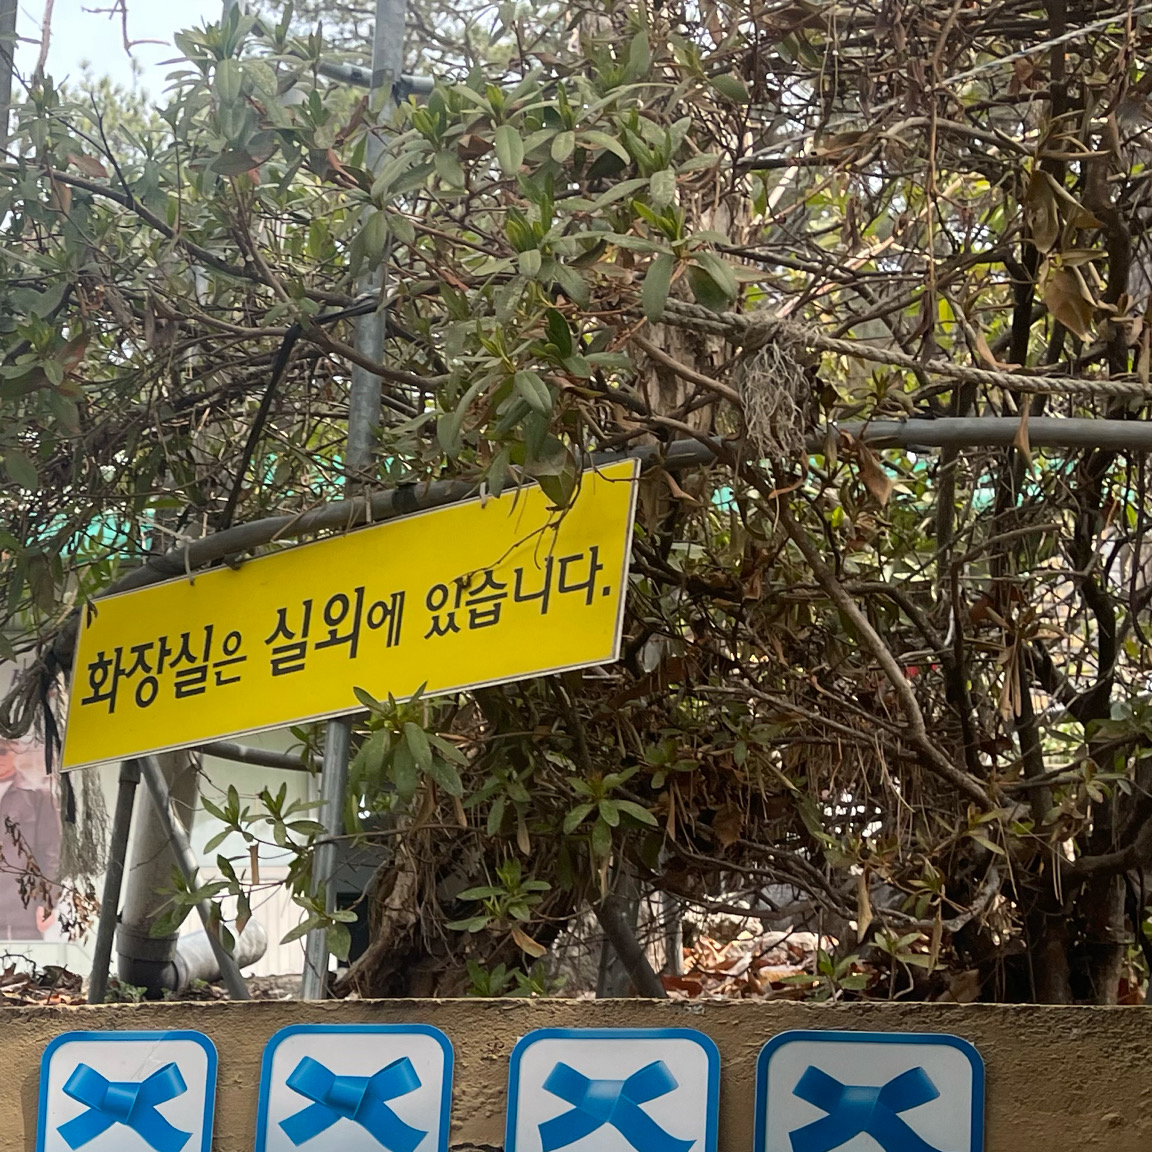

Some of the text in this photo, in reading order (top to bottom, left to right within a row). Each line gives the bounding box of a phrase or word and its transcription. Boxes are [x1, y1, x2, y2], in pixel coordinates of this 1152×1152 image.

[81, 546, 611, 714] 화장실은 실외에 있습니다.
